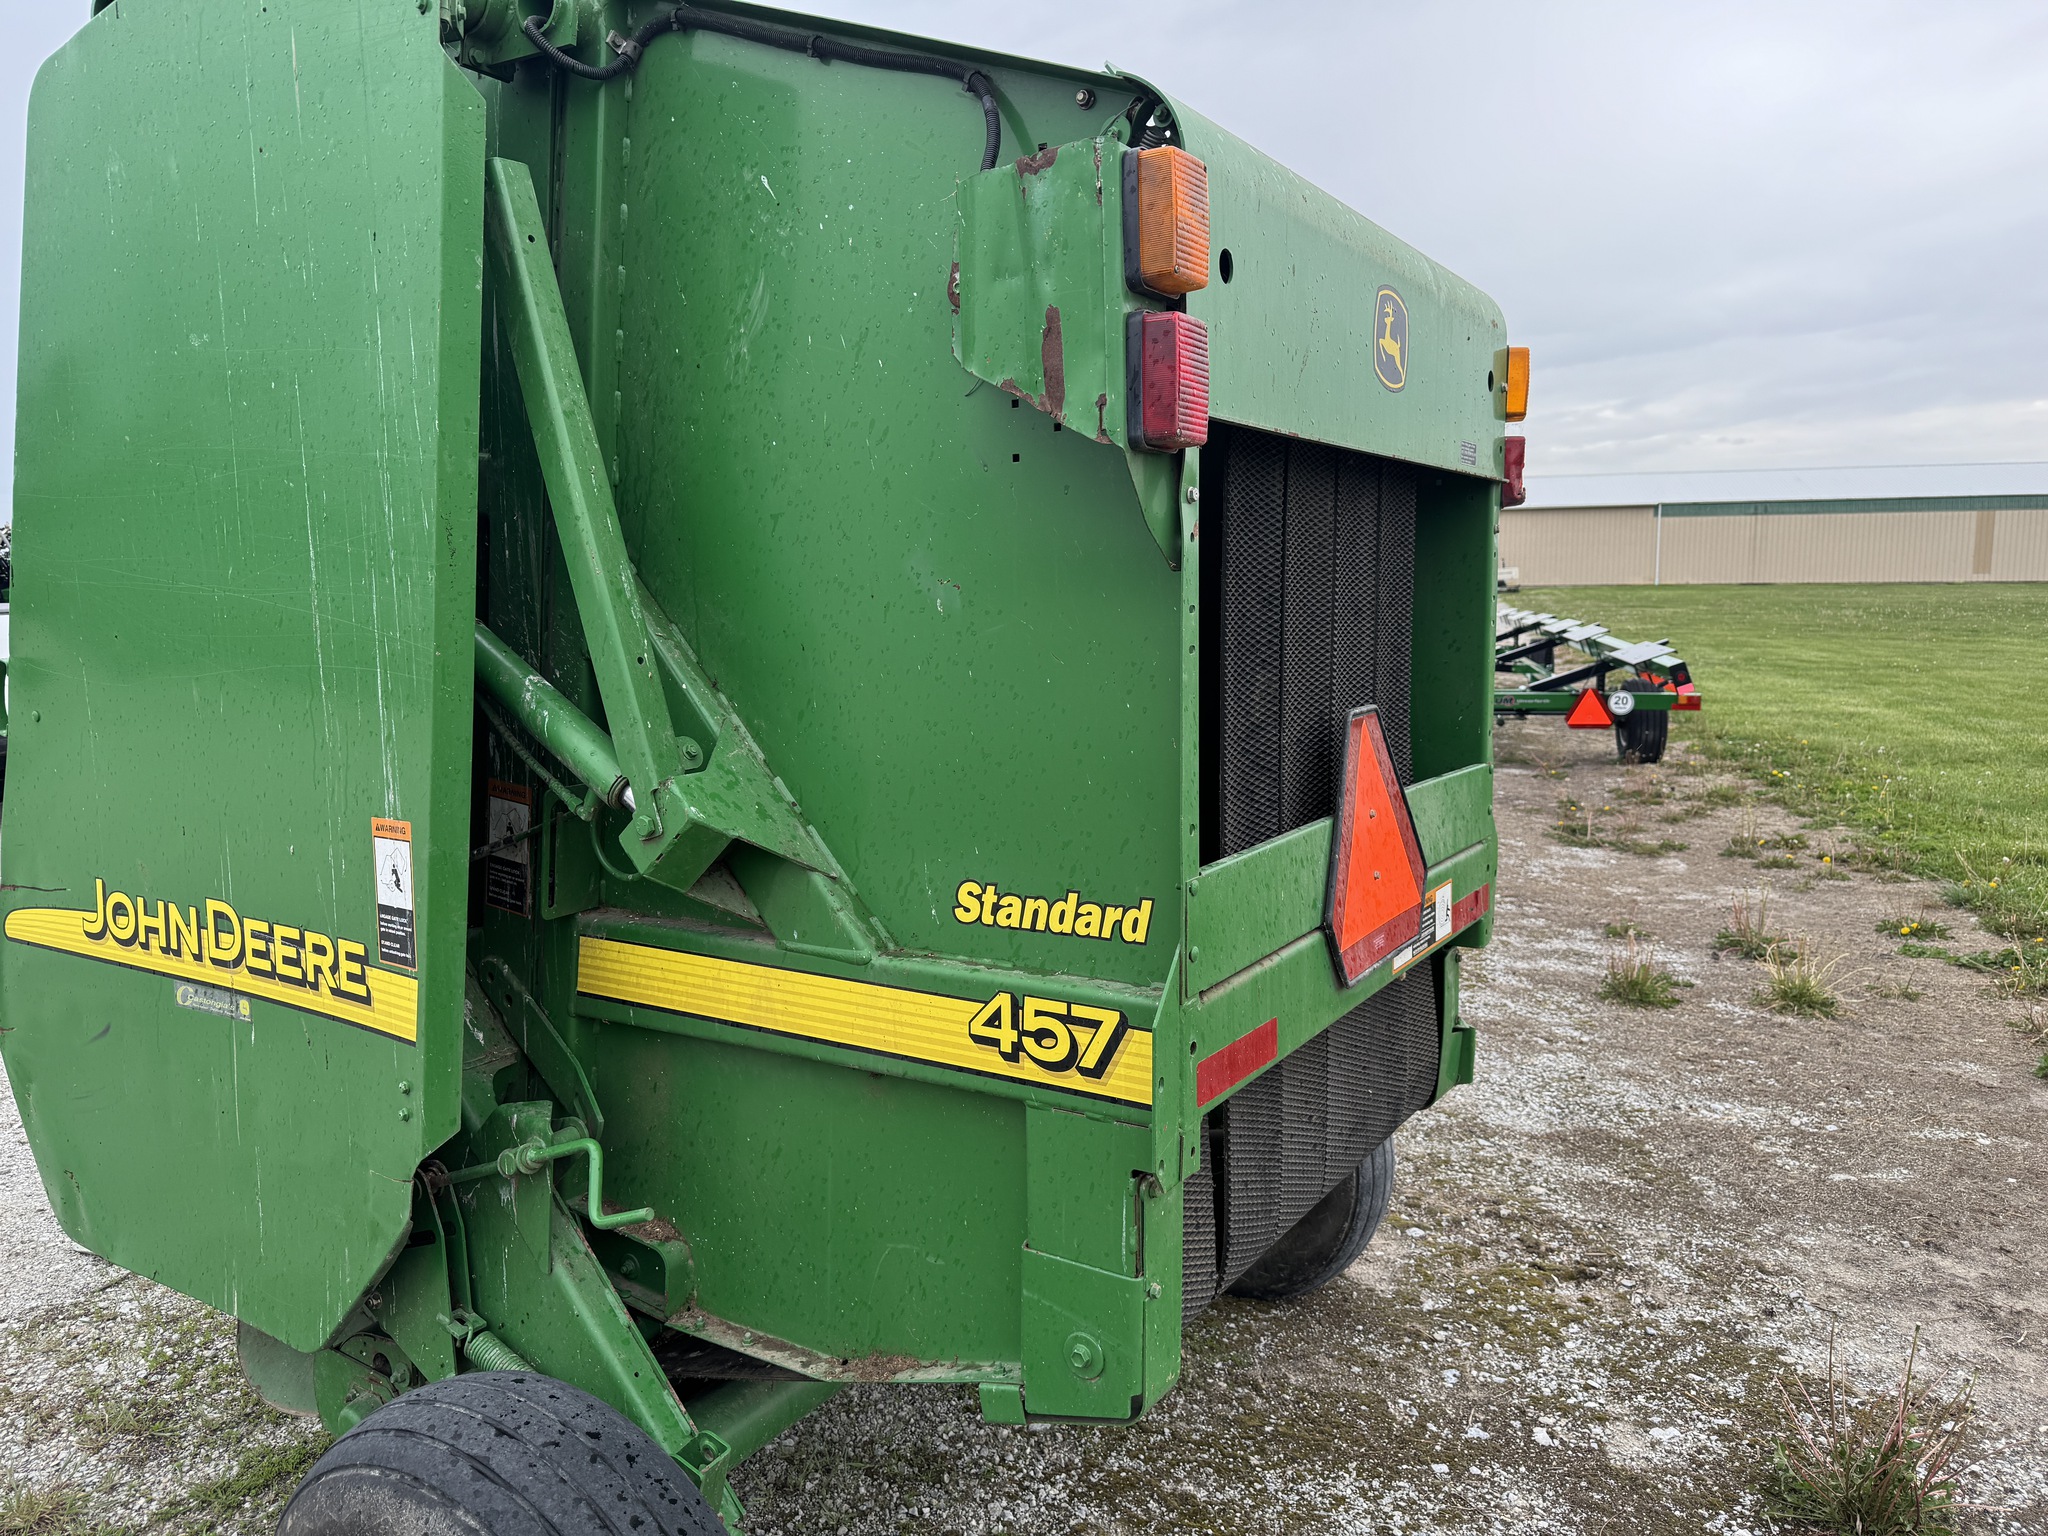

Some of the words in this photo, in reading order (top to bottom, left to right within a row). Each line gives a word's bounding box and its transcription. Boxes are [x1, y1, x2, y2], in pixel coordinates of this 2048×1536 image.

[1614, 695, 1628, 705] 20
[380, 824, 406, 835] WARNING
[83, 877, 199, 958] JOHN
[205, 897, 371, 1003] DEERE
[953, 880, 1154, 944] Standard
[969, 991, 1128, 1079] 457
